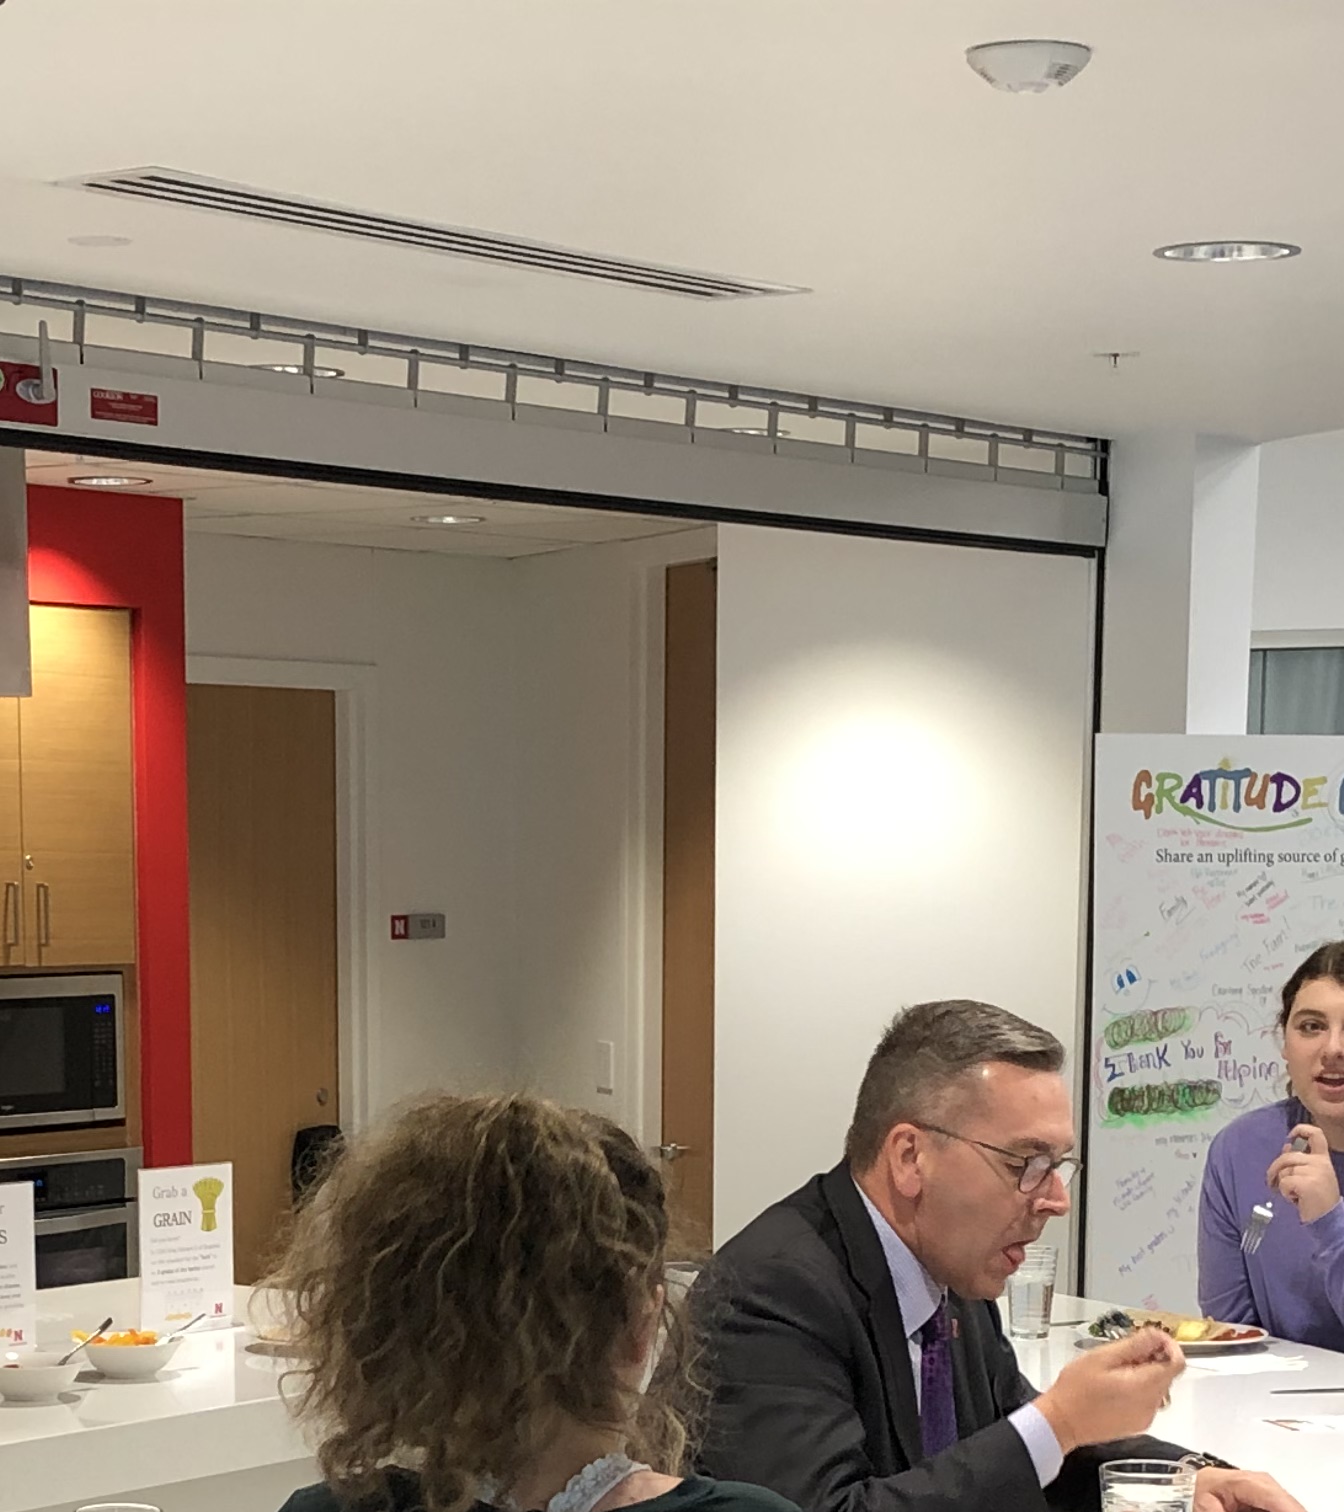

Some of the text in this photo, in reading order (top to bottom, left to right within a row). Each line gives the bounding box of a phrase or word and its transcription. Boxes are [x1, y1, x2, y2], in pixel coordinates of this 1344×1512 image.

[1132, 758, 1328, 822] GRATITUDE
[1155, 848, 1194, 863] Share
[1197, 852, 1213, 863] an
[1217, 848, 1275, 867] uplifting
[1277, 852, 1321, 863] source
[1323, 848, 1340, 863] of
[152, 1185, 188, 1200] Grab a
[153, 1210, 192, 1228] GRAIN
